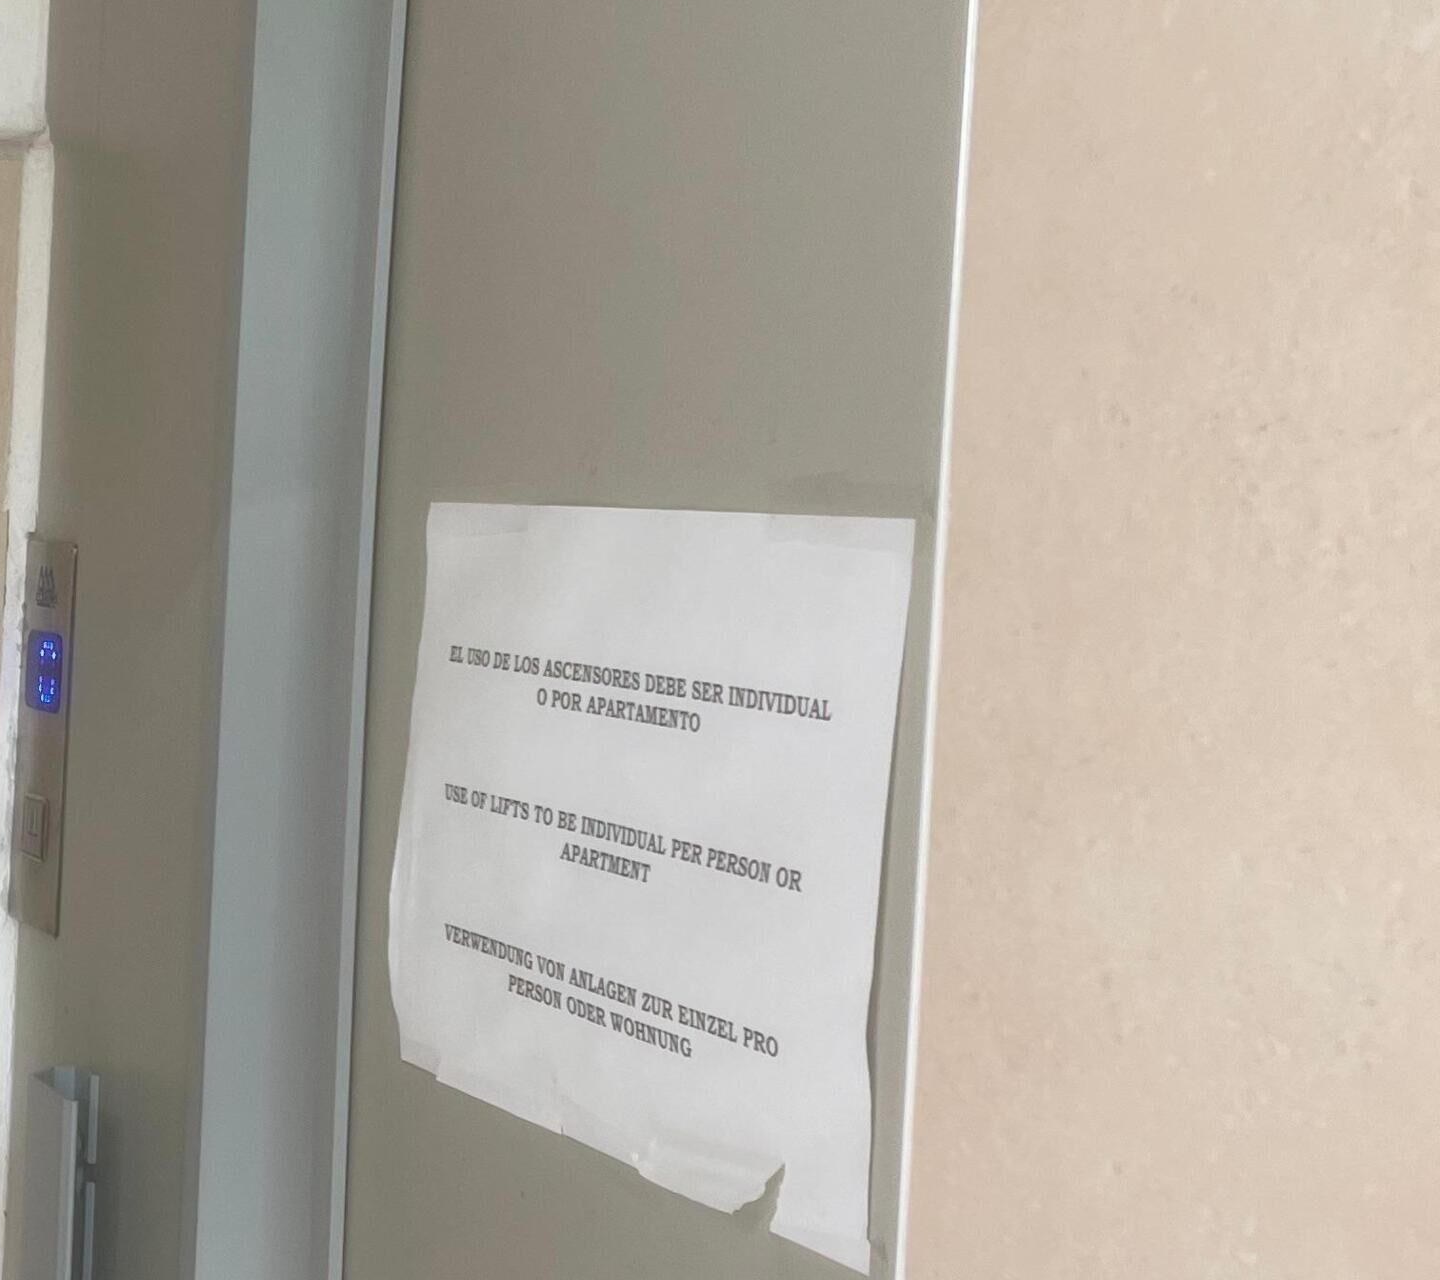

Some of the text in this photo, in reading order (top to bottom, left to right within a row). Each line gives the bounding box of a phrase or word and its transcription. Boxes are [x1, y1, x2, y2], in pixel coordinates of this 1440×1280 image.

[449, 645, 831, 721] EL USO DE LOS ASCENSORES DEBE SER INDIVIDUAL
[537, 688, 701, 732] O POR APARTAMENTO
[445, 783, 802, 892] USE OF LIFTS TO BE INDIVIDUAL PER PERSON OR
[560, 842, 651, 883] APARTMENT
[445, 923, 778, 1057] VERWENDUNG VON ANLAGEN ZUR EINZEL PRO
[508, 974, 692, 1058] PERSON ODER WOHNUNG
